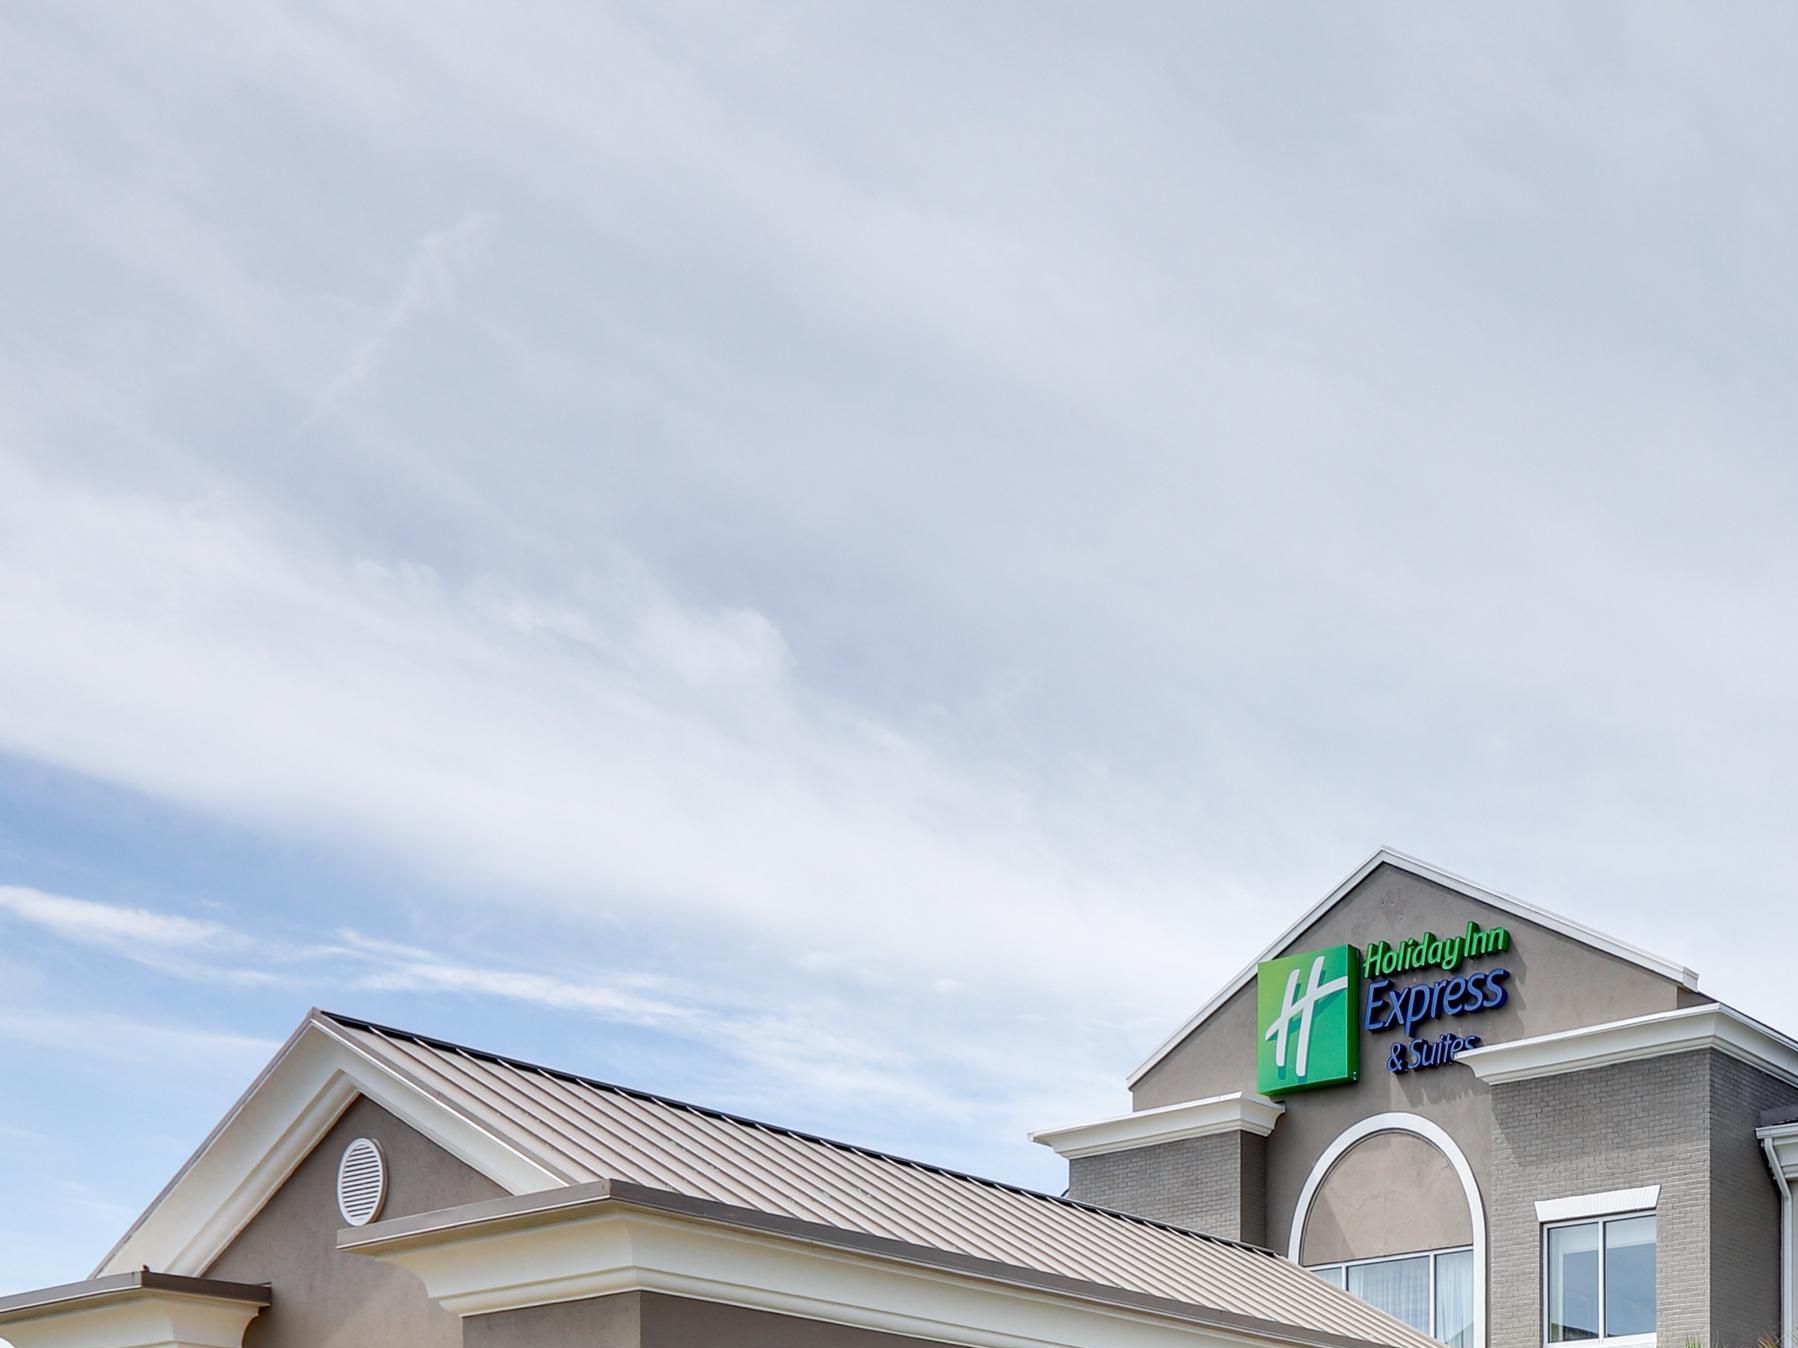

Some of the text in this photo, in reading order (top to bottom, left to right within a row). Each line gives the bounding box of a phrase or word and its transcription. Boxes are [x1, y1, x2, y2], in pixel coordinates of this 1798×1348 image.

[1363, 920, 1510, 978] Holiday Inn
[1264, 955, 1348, 1077] H
[1364, 967, 1510, 1037] Express
[1386, 1042, 1408, 1073] &
